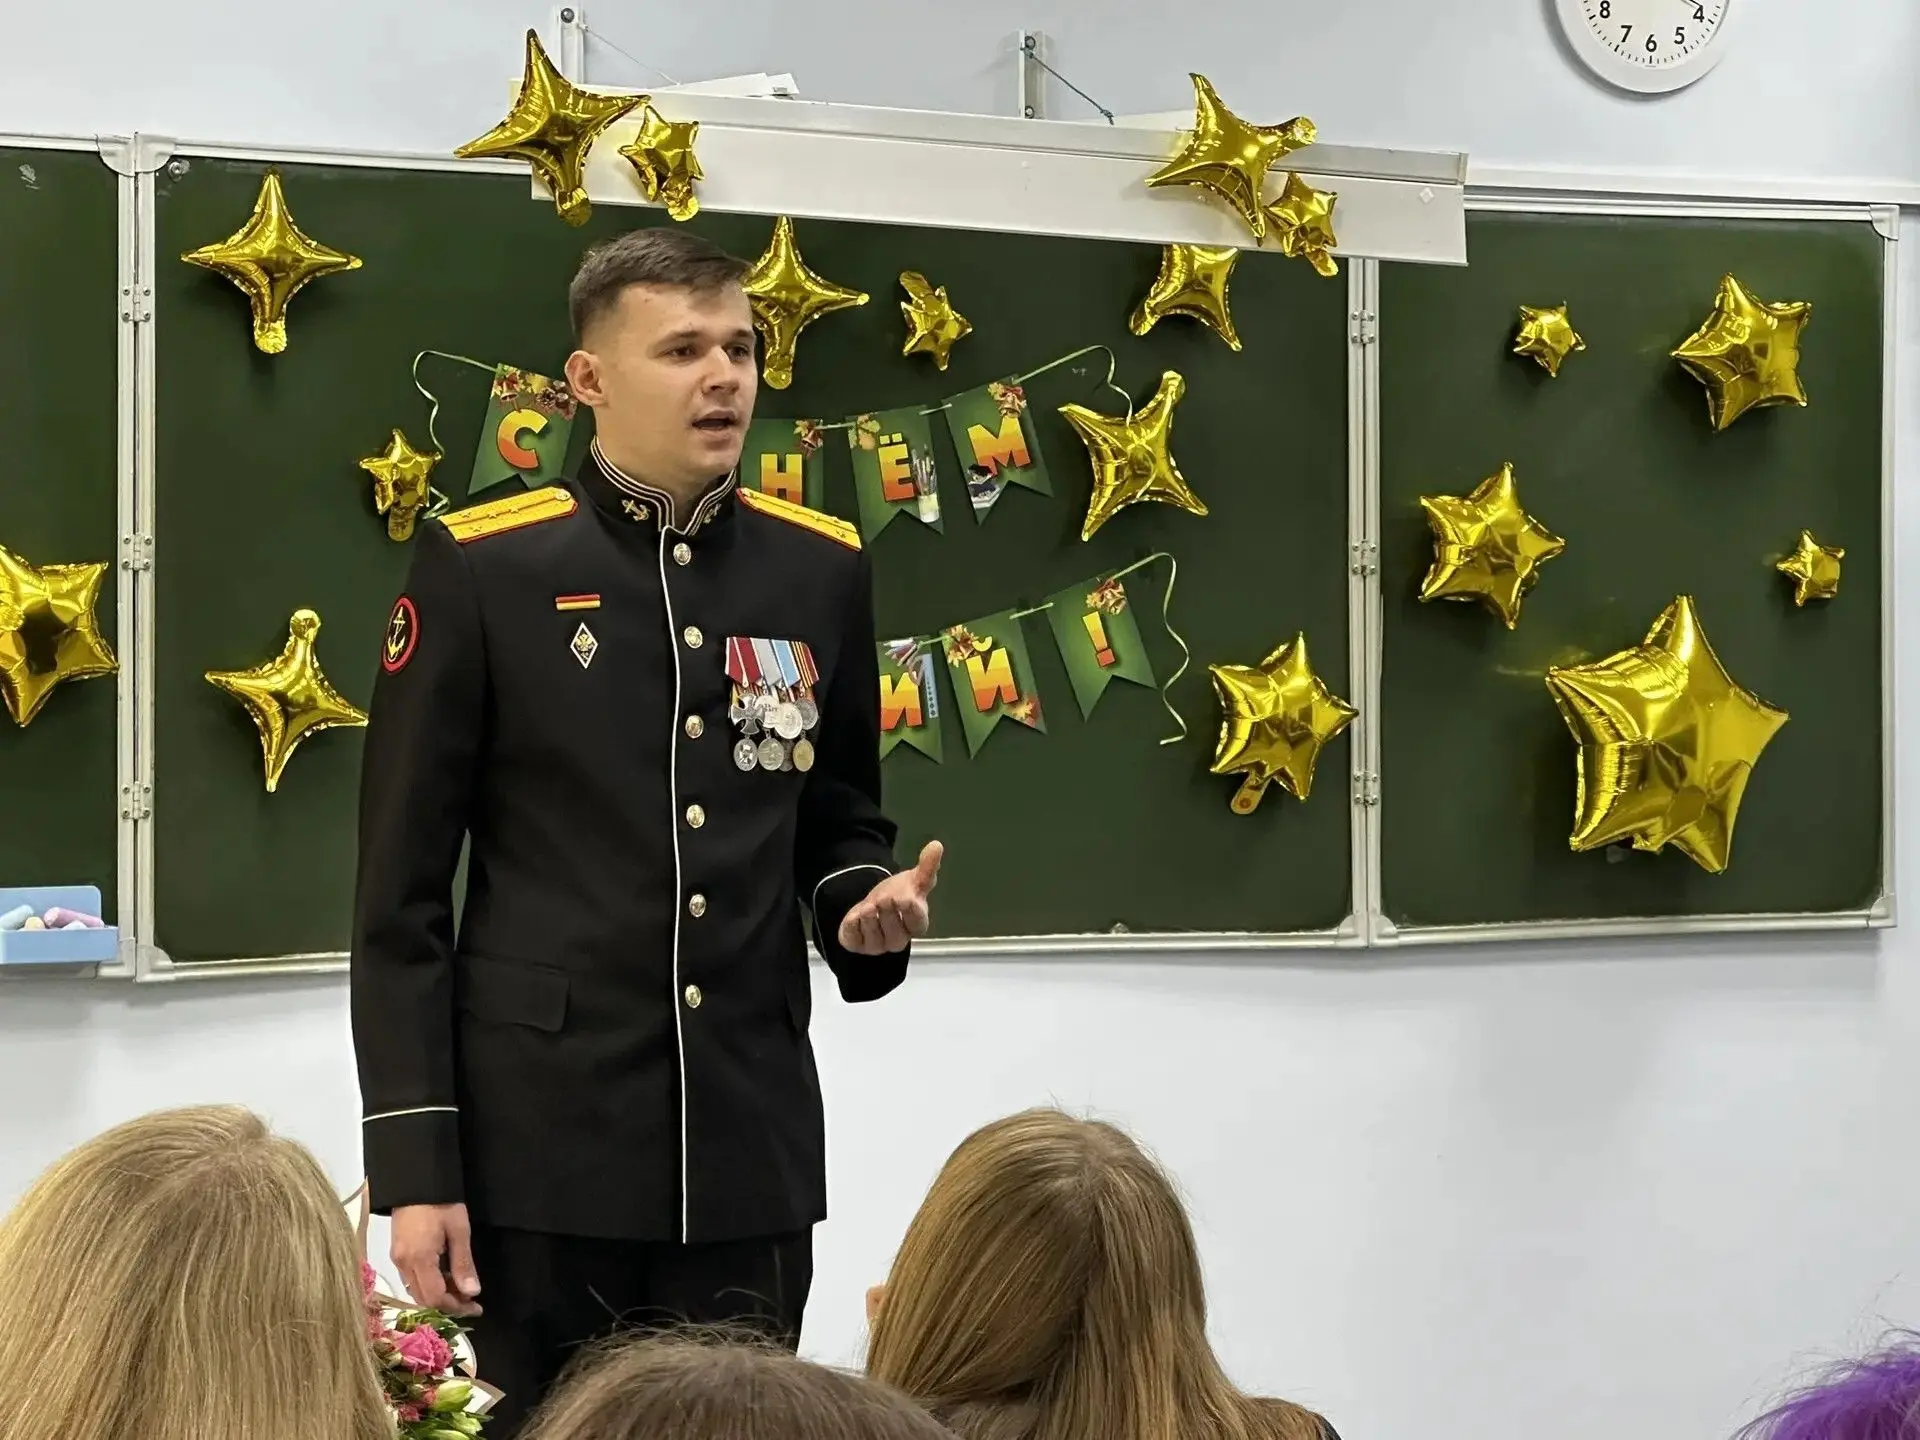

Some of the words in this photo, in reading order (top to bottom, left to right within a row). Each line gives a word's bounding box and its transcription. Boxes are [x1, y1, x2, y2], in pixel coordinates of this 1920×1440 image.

[1600, 0, 1611, 19] 8
[1692, 5, 1705, 23] 4
[1620, 25, 1633, 43] 7
[1645, 34, 1658, 53] 6
[1673, 26, 1685, 45] 5
[760, 415, 1031, 506] НЁМ
[880, 611, 1116, 731] ИЙ!
